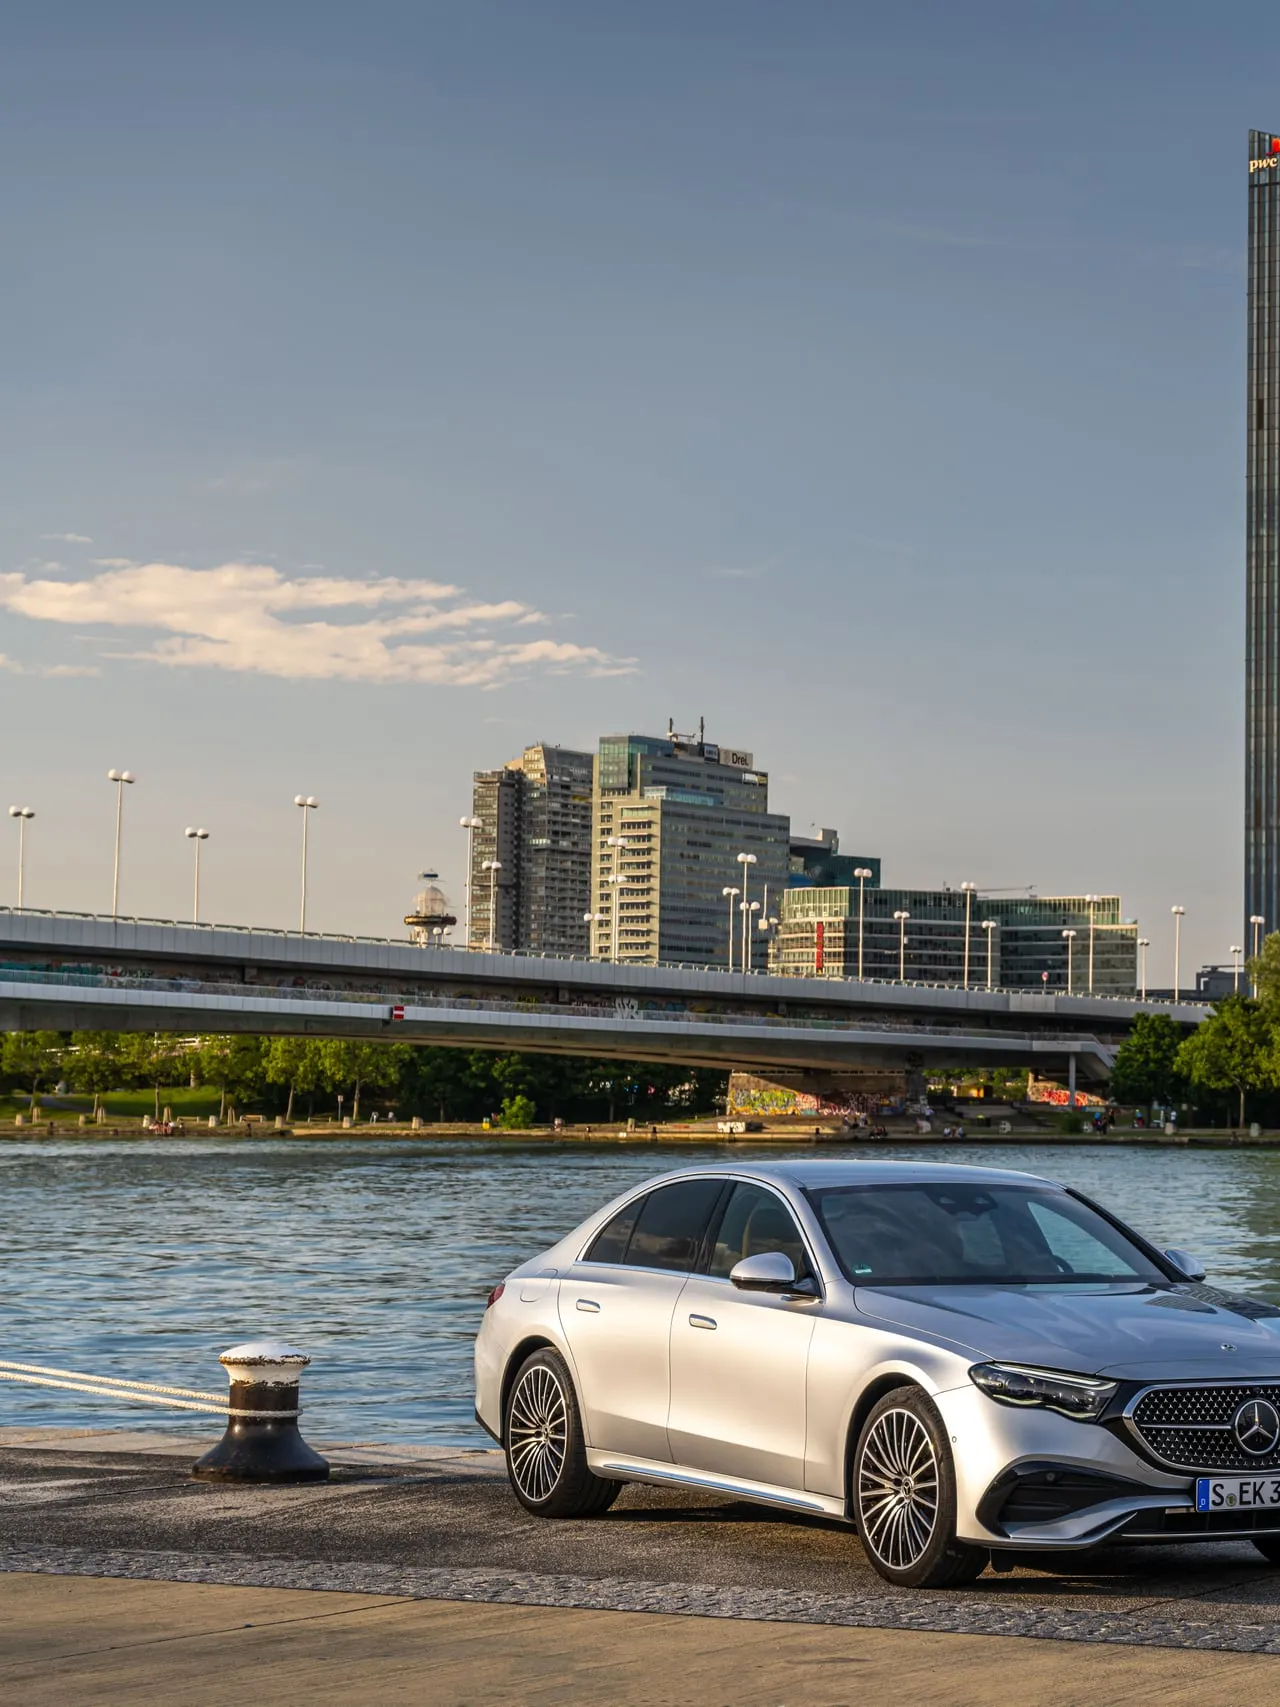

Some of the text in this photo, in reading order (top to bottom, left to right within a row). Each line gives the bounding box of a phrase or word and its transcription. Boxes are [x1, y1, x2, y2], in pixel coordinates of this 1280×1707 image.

[1249, 157, 1278, 173] pwc
[1211, 1484, 1225, 1507] S
[1239, 1482, 1266, 1505] EK
